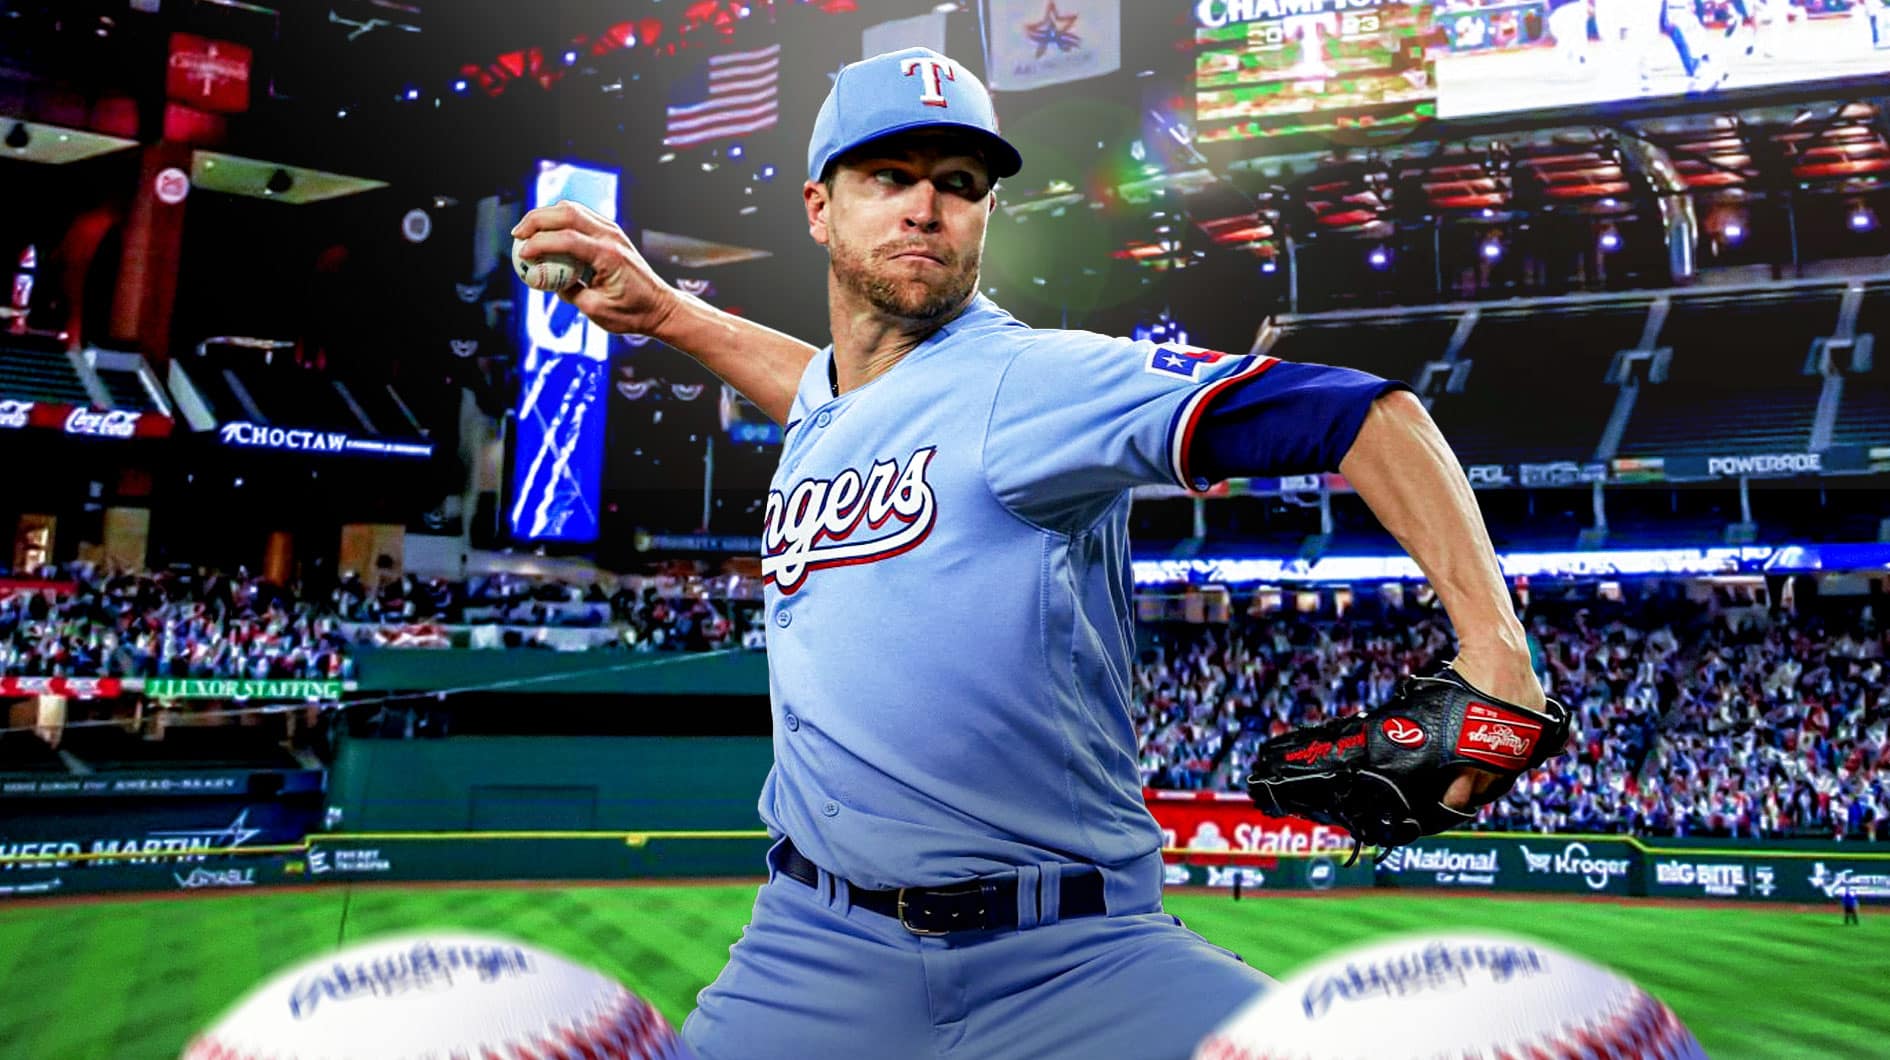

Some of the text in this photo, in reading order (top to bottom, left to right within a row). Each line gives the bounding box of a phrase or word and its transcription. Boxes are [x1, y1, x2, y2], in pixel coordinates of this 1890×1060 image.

[1197, 0, 1427, 27] CHAMP
[900, 57, 955, 107] T
[235, 422, 346, 451] CHOCTAW
[1469, 723, 1531, 756] Rawlings
[91, 837, 211, 865] MARTIN
[1234, 823, 1308, 853] State
[1404, 847, 1499, 871] National
[1554, 843, 1629, 889] Kroger
[1656, 860, 1746, 886] BIG BITE
